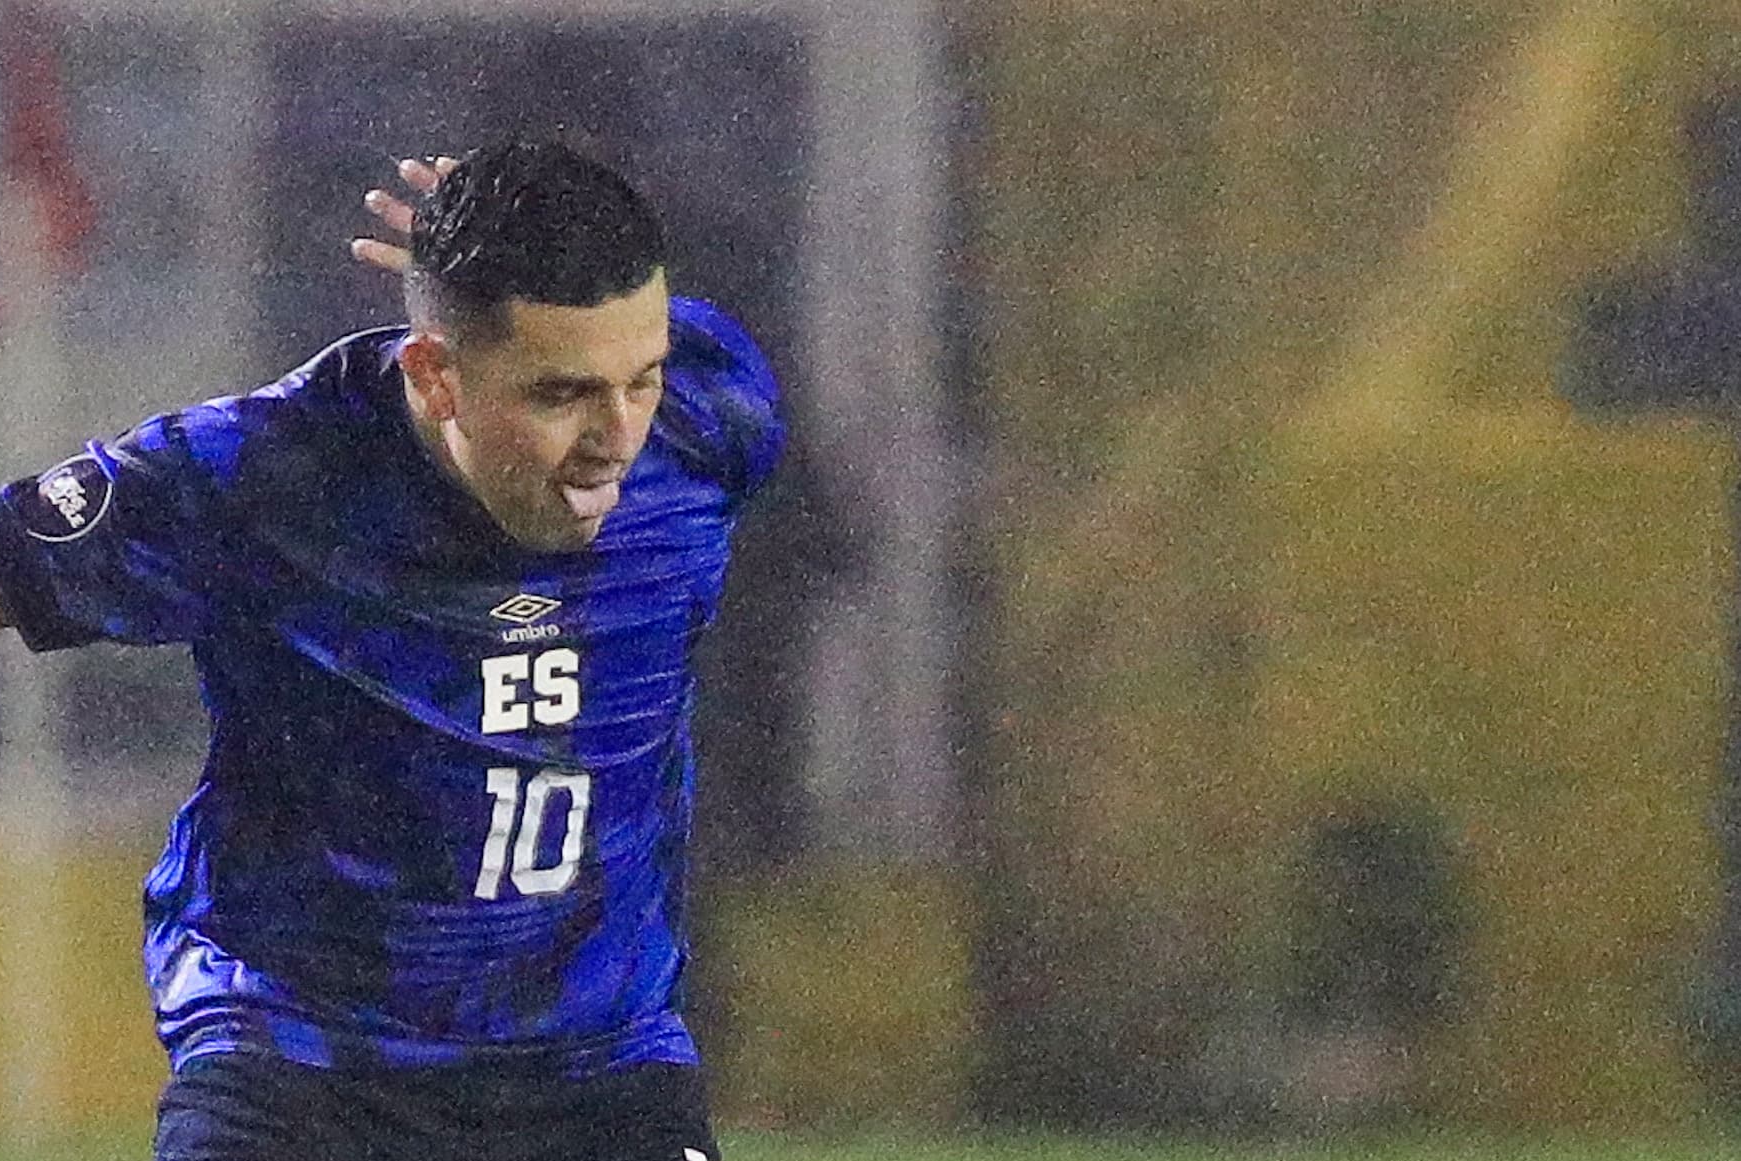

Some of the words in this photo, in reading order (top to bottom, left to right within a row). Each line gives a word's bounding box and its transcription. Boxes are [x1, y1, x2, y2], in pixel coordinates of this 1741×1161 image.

[502, 624, 560, 643] umbro
[481, 647, 580, 735] ES
[473, 766, 591, 900] 10
